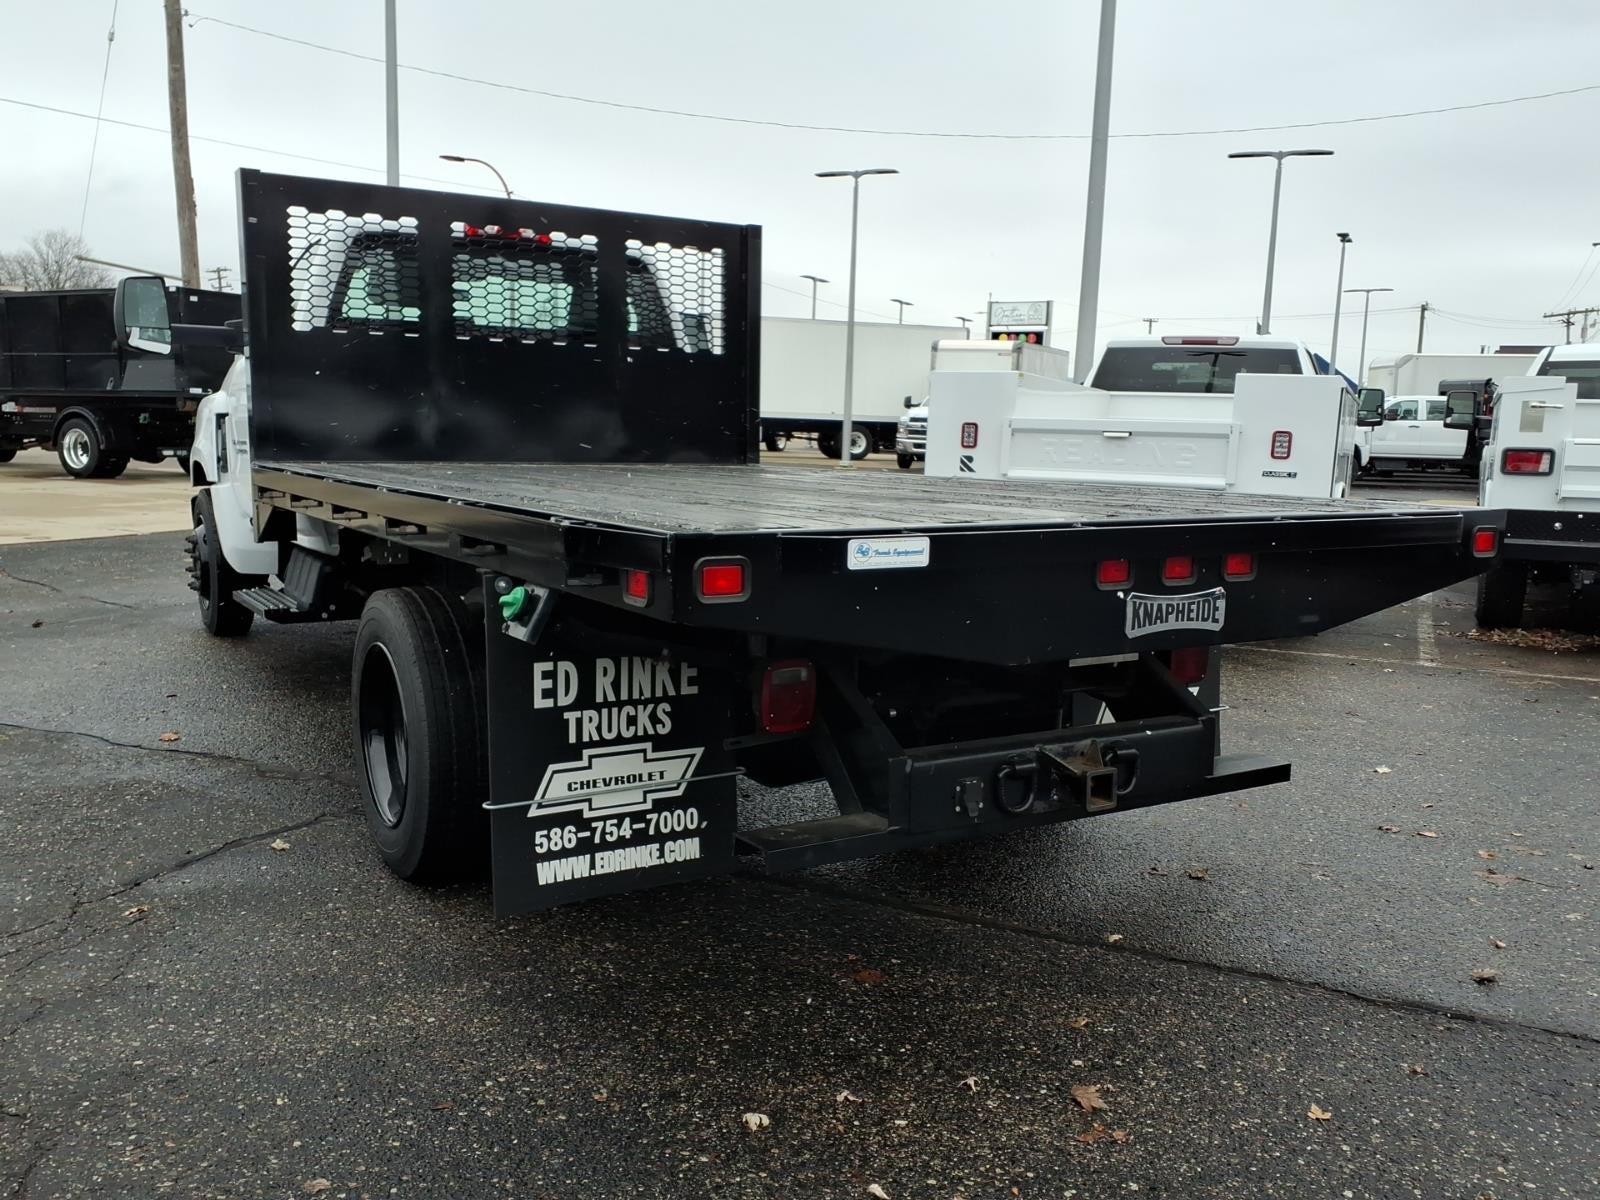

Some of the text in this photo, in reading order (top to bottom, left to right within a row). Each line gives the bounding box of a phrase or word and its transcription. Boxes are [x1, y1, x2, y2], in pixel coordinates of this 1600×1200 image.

[1131, 597, 1220, 631] KNAPHEIDE
[533, 656, 698, 709] ED RINKE
[563, 702, 672, 744] TRUCKS
[567, 769, 667, 792] CHEVROLET
[534, 807, 699, 854] 586-754-7000
[536, 836, 700, 886] WWW.EDRINKE.COM
